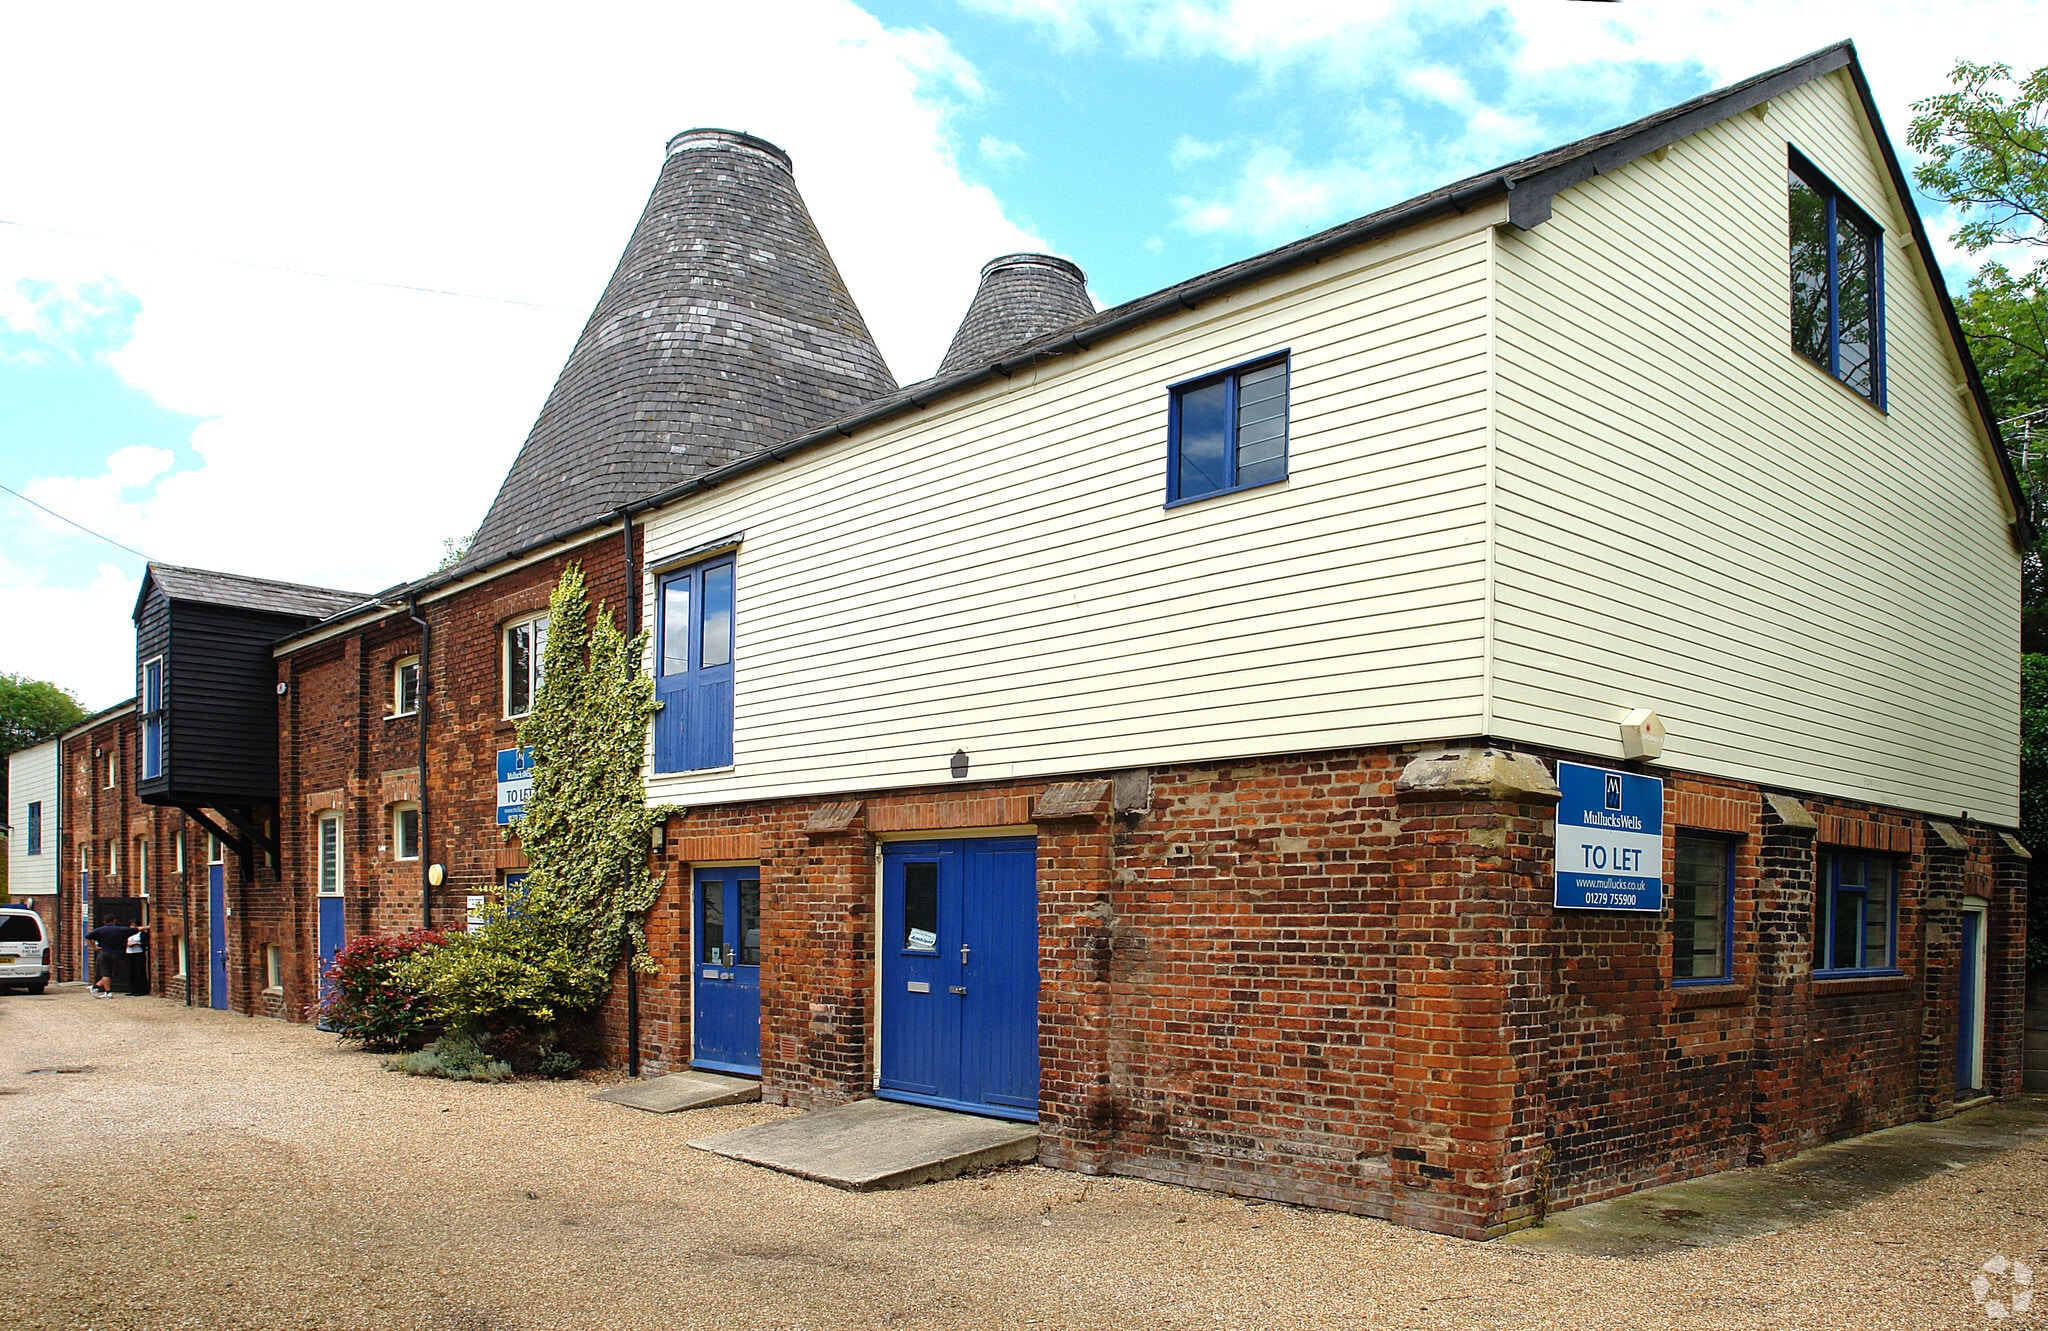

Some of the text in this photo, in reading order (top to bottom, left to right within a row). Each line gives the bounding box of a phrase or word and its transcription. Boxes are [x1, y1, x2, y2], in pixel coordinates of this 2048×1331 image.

[506, 790, 518, 803] TO
[1583, 809, 1642, 830] MullucksWells
[1581, 844, 1642, 872] TO LET
[1576, 877, 1646, 891] www.mullucks.co.uk
[1585, 892, 1637, 906] 01279 755900
